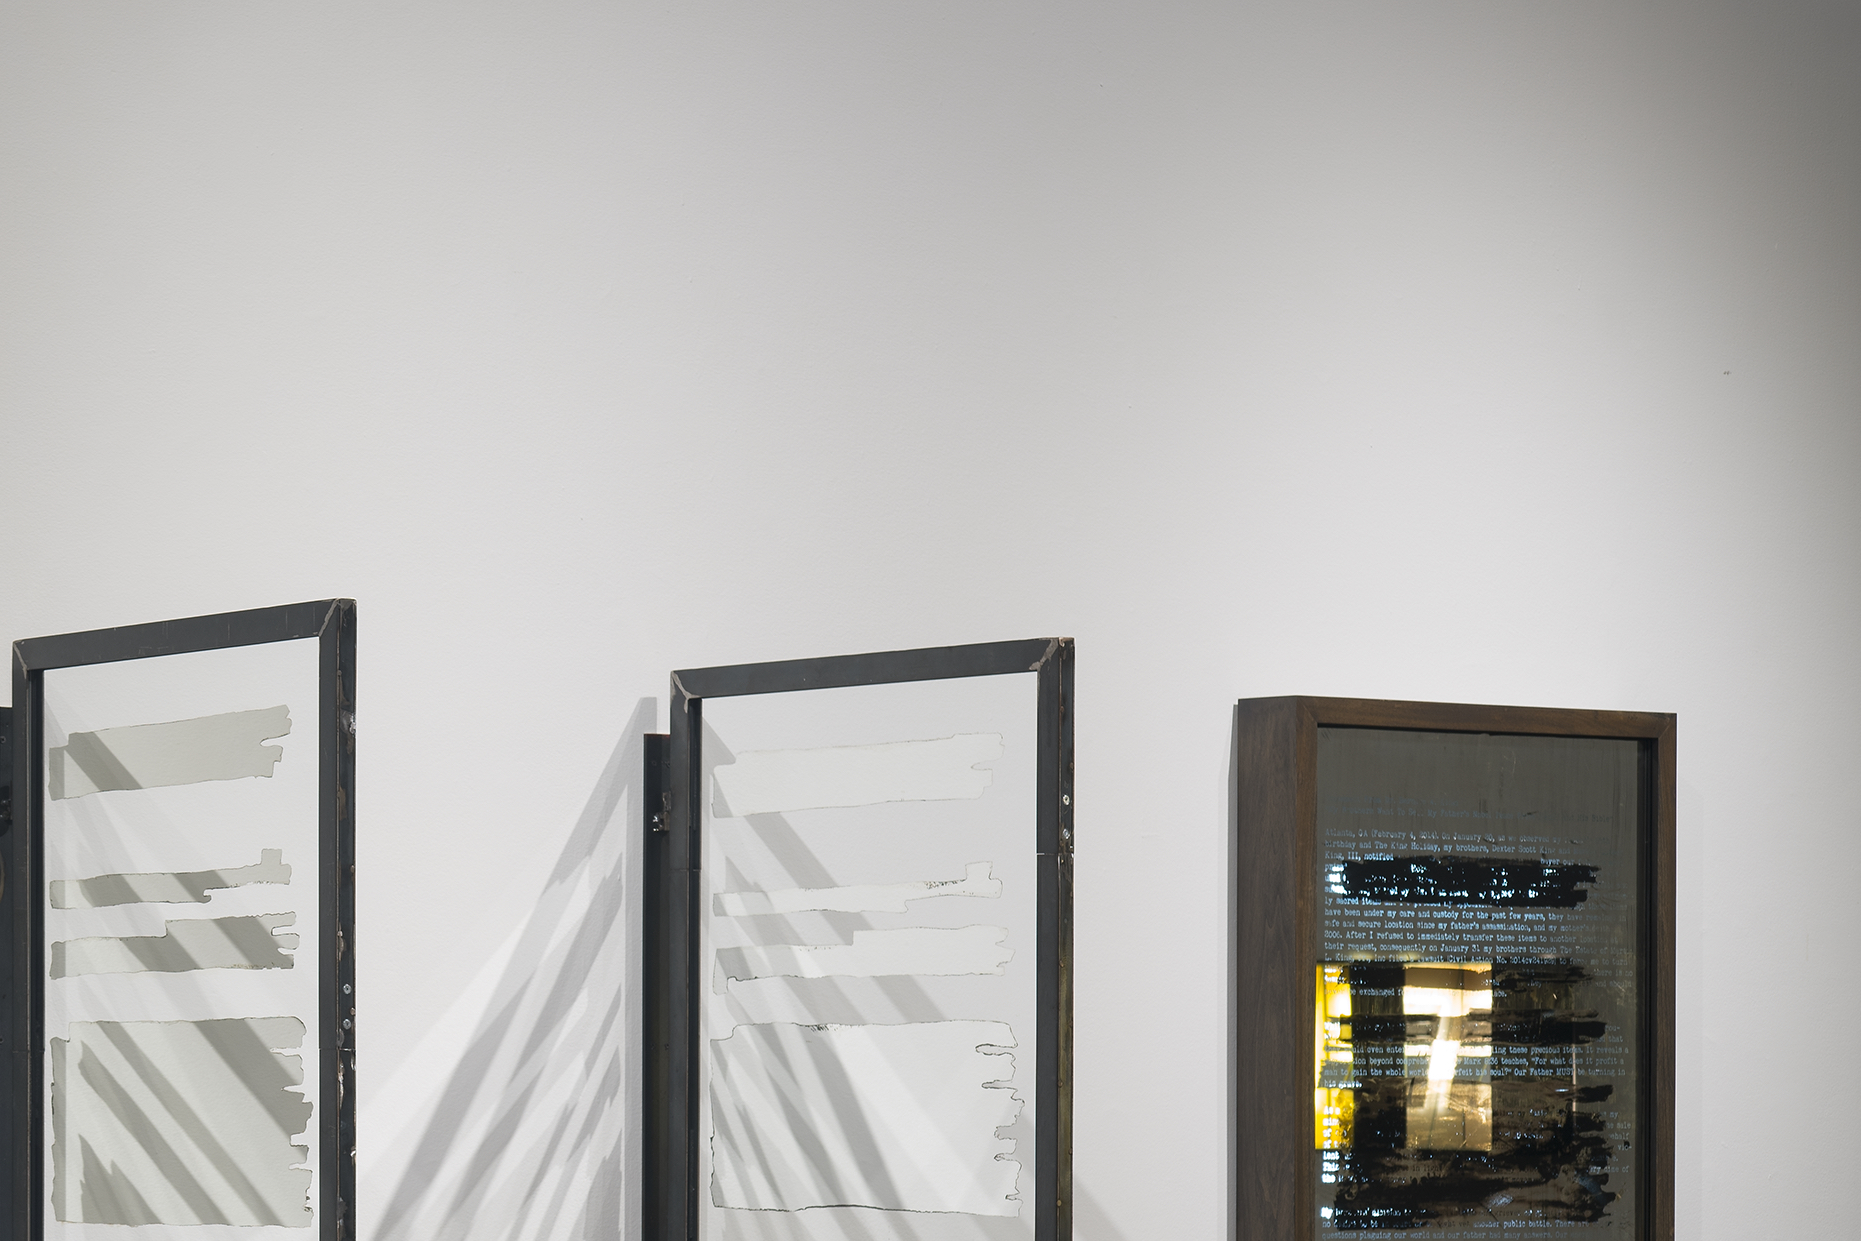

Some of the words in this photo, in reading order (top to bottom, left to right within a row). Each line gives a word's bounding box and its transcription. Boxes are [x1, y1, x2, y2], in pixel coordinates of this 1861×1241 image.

[1492, 845, 1515, 853] Dexter
[1348, 852, 1361, 861] III,
[1433, 911, 1459, 919] custody
[1492, 912, 1506, 920] past
[1385, 921, 1414, 929] location
[1530, 1068, 1553, 1076] Father
[1504, 1220, 1525, 1228] public
[1359, 1232, 1391, 1241] plaguing
